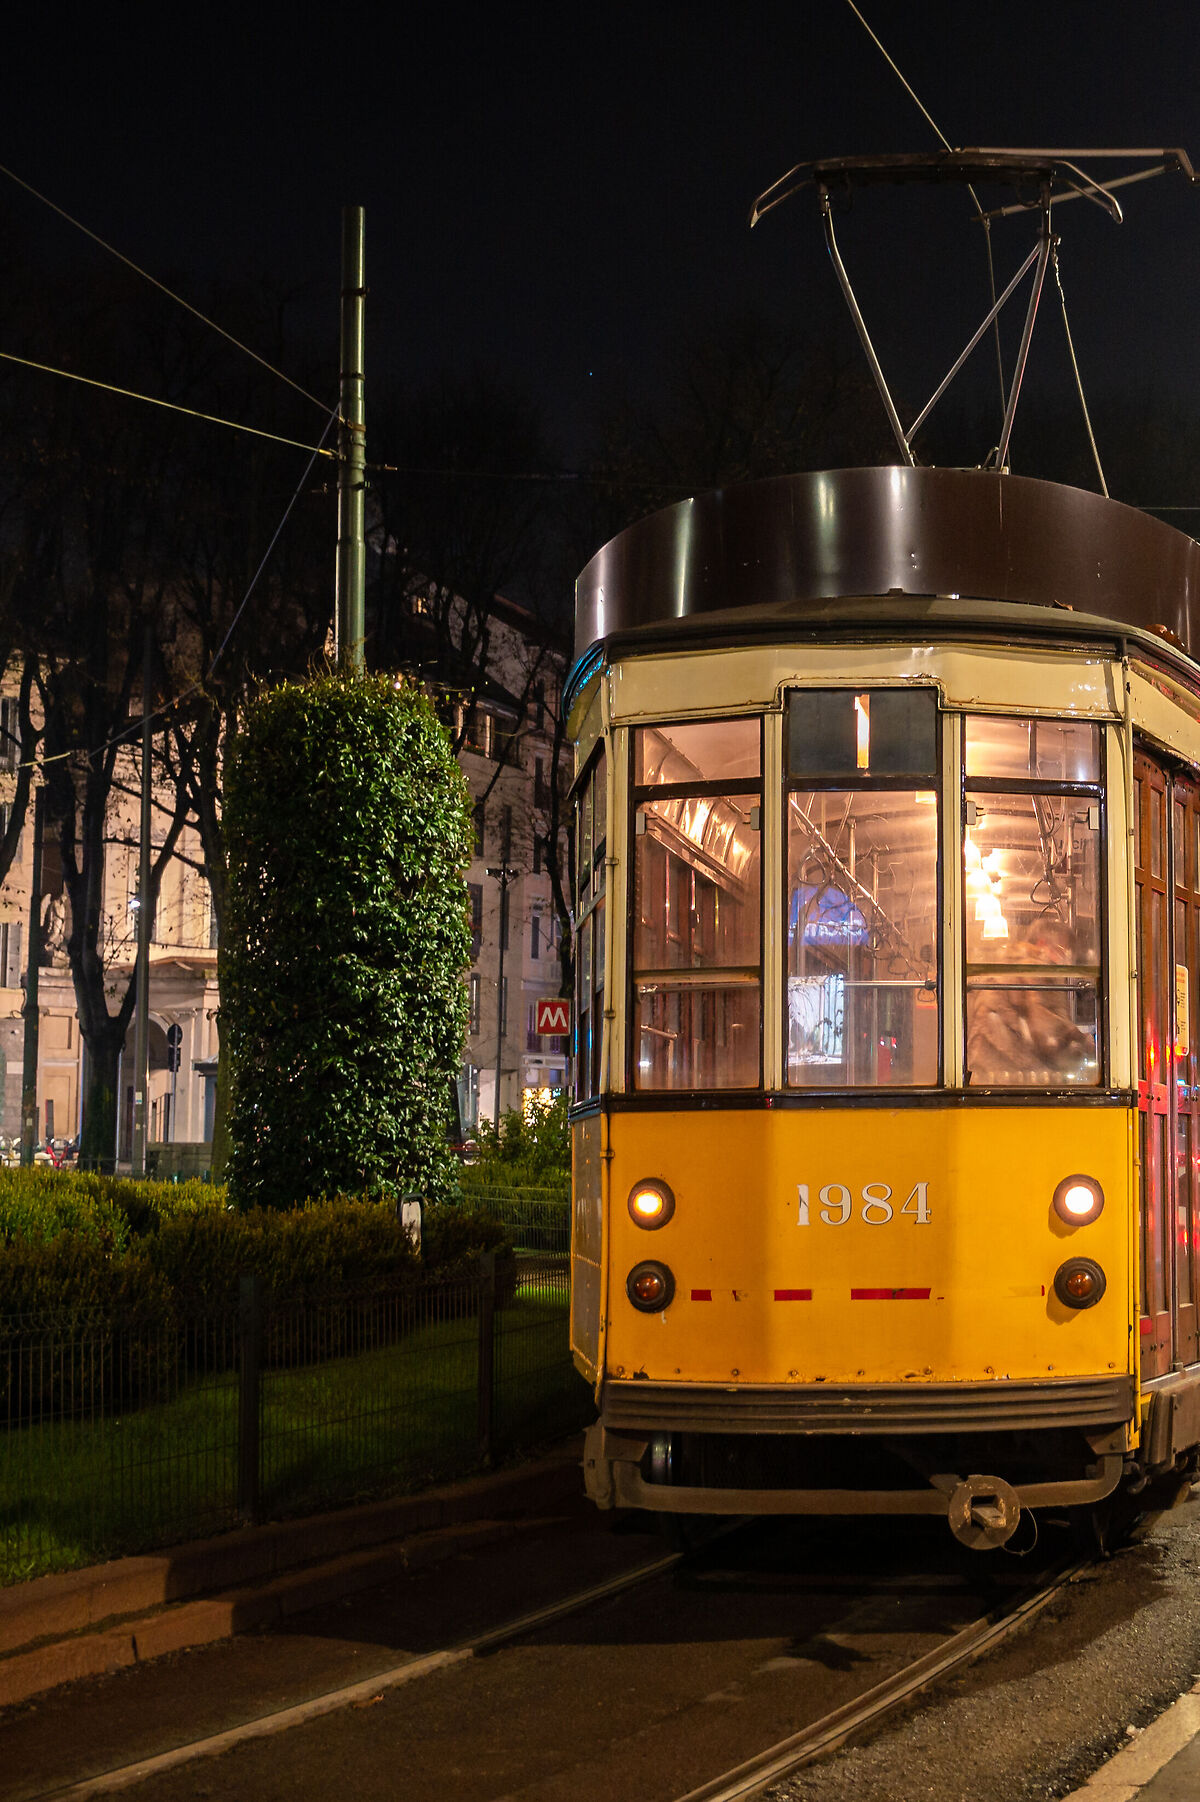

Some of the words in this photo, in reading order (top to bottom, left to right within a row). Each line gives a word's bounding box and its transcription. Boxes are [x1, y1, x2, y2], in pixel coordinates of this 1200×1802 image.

[853, 692, 870, 769] 1
[539, 1006, 568, 1028] M
[796, 1182, 933, 1226] 1984
